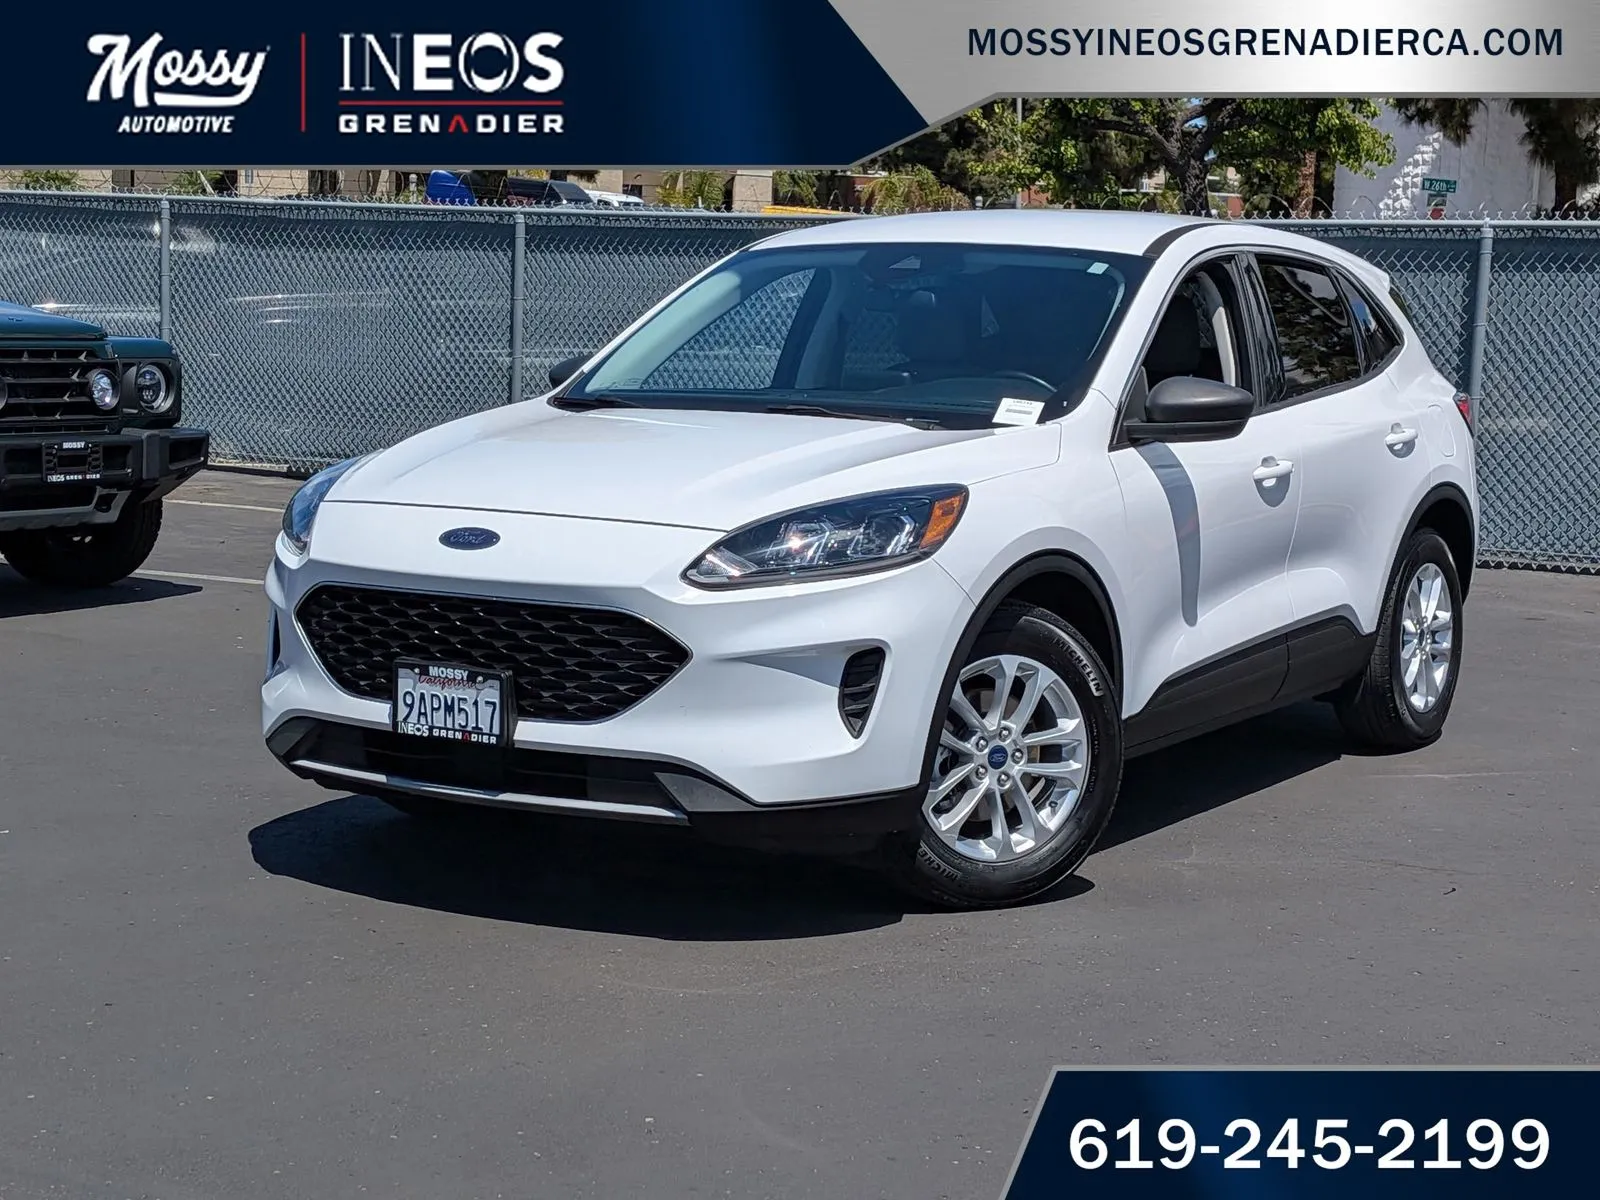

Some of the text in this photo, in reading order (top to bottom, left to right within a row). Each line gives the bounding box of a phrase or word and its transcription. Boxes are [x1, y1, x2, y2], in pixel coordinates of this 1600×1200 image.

[1432, 180, 1447, 191] 26th
[428, 665, 469, 681] MOSSY
[402, 690, 498, 734] 9APM517
[397, 720, 497, 745] INEOS GRENADIER
